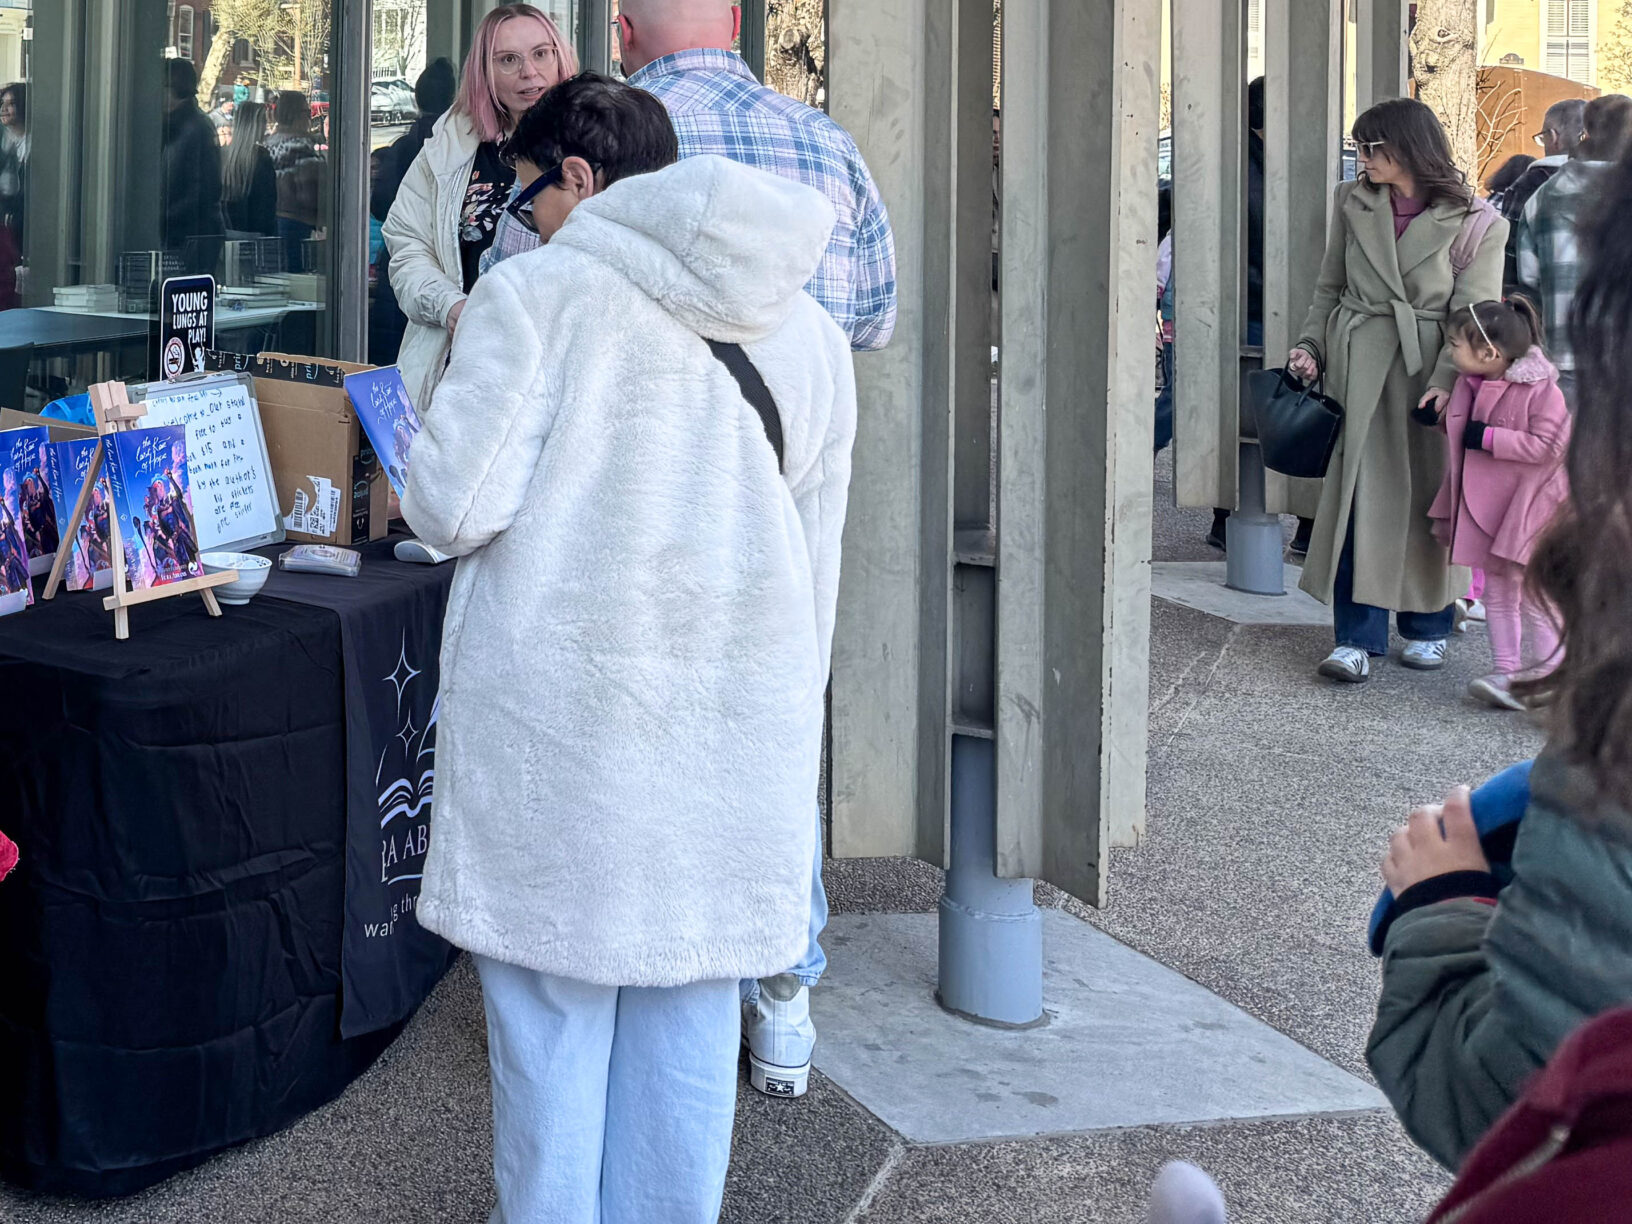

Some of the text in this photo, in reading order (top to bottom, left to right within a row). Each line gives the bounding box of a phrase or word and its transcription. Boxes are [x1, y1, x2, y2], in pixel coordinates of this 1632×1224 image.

[171, 291, 208, 313] YOUNG
[173, 312, 208, 330] LUNGS AT
[187, 327, 207, 344] PLAY!
